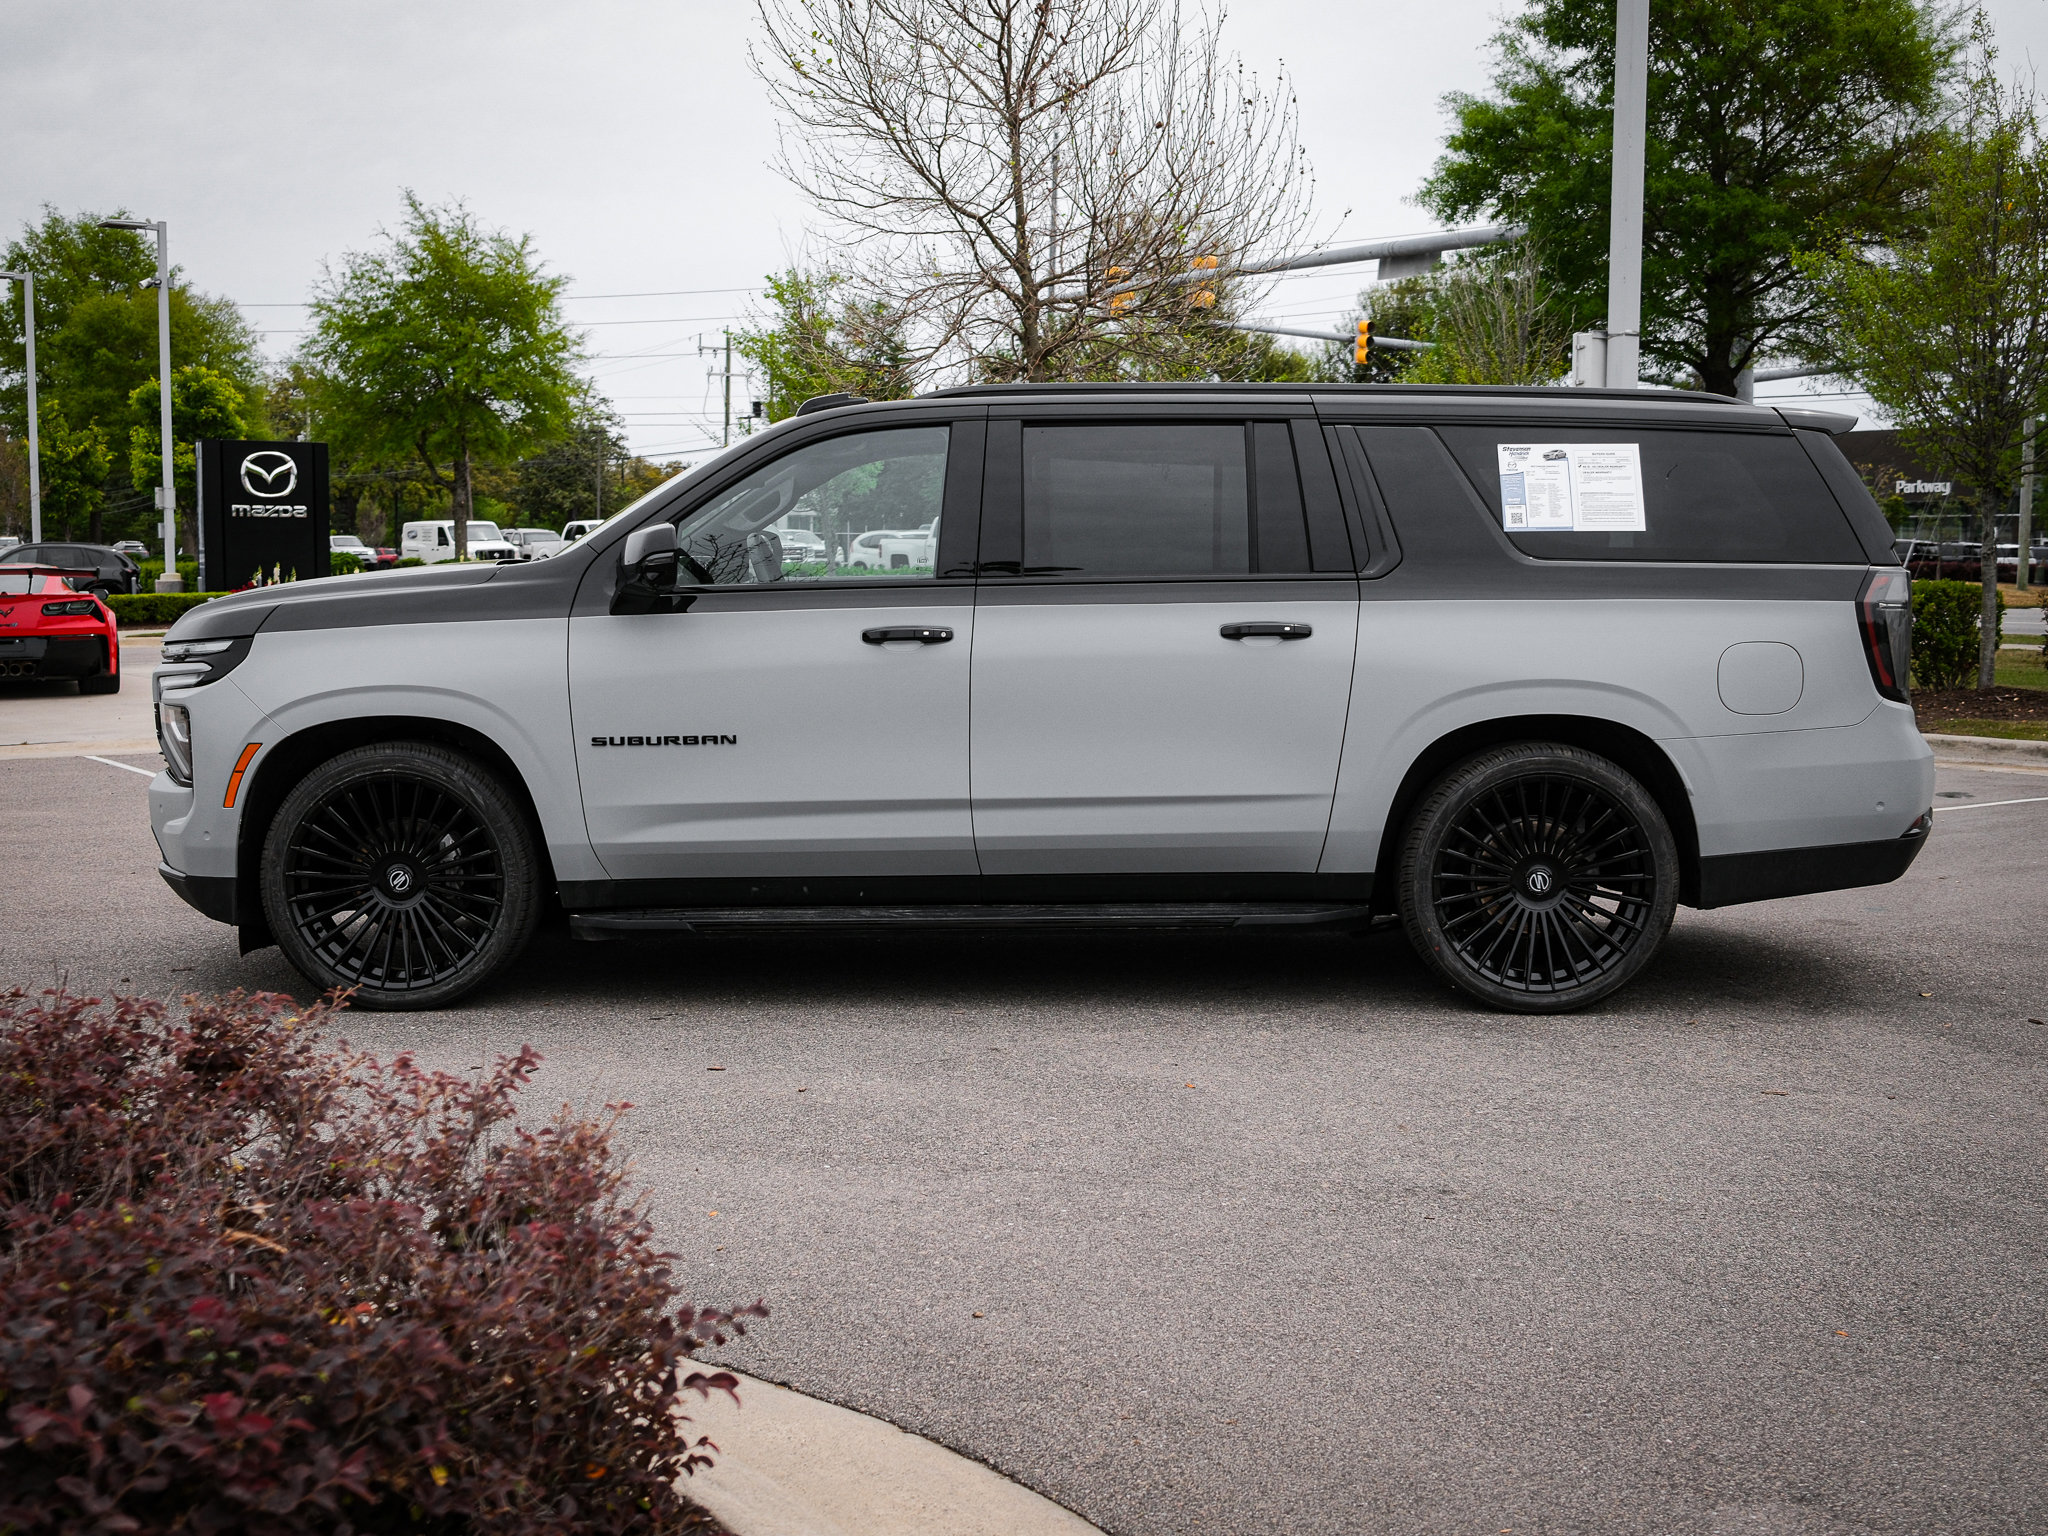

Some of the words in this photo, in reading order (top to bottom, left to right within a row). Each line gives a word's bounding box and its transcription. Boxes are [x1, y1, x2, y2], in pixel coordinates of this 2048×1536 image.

[1895, 480, 1951, 496] Parkway
[231, 504, 308, 518] mazda
[591, 734, 737, 747] SUBURBAN
